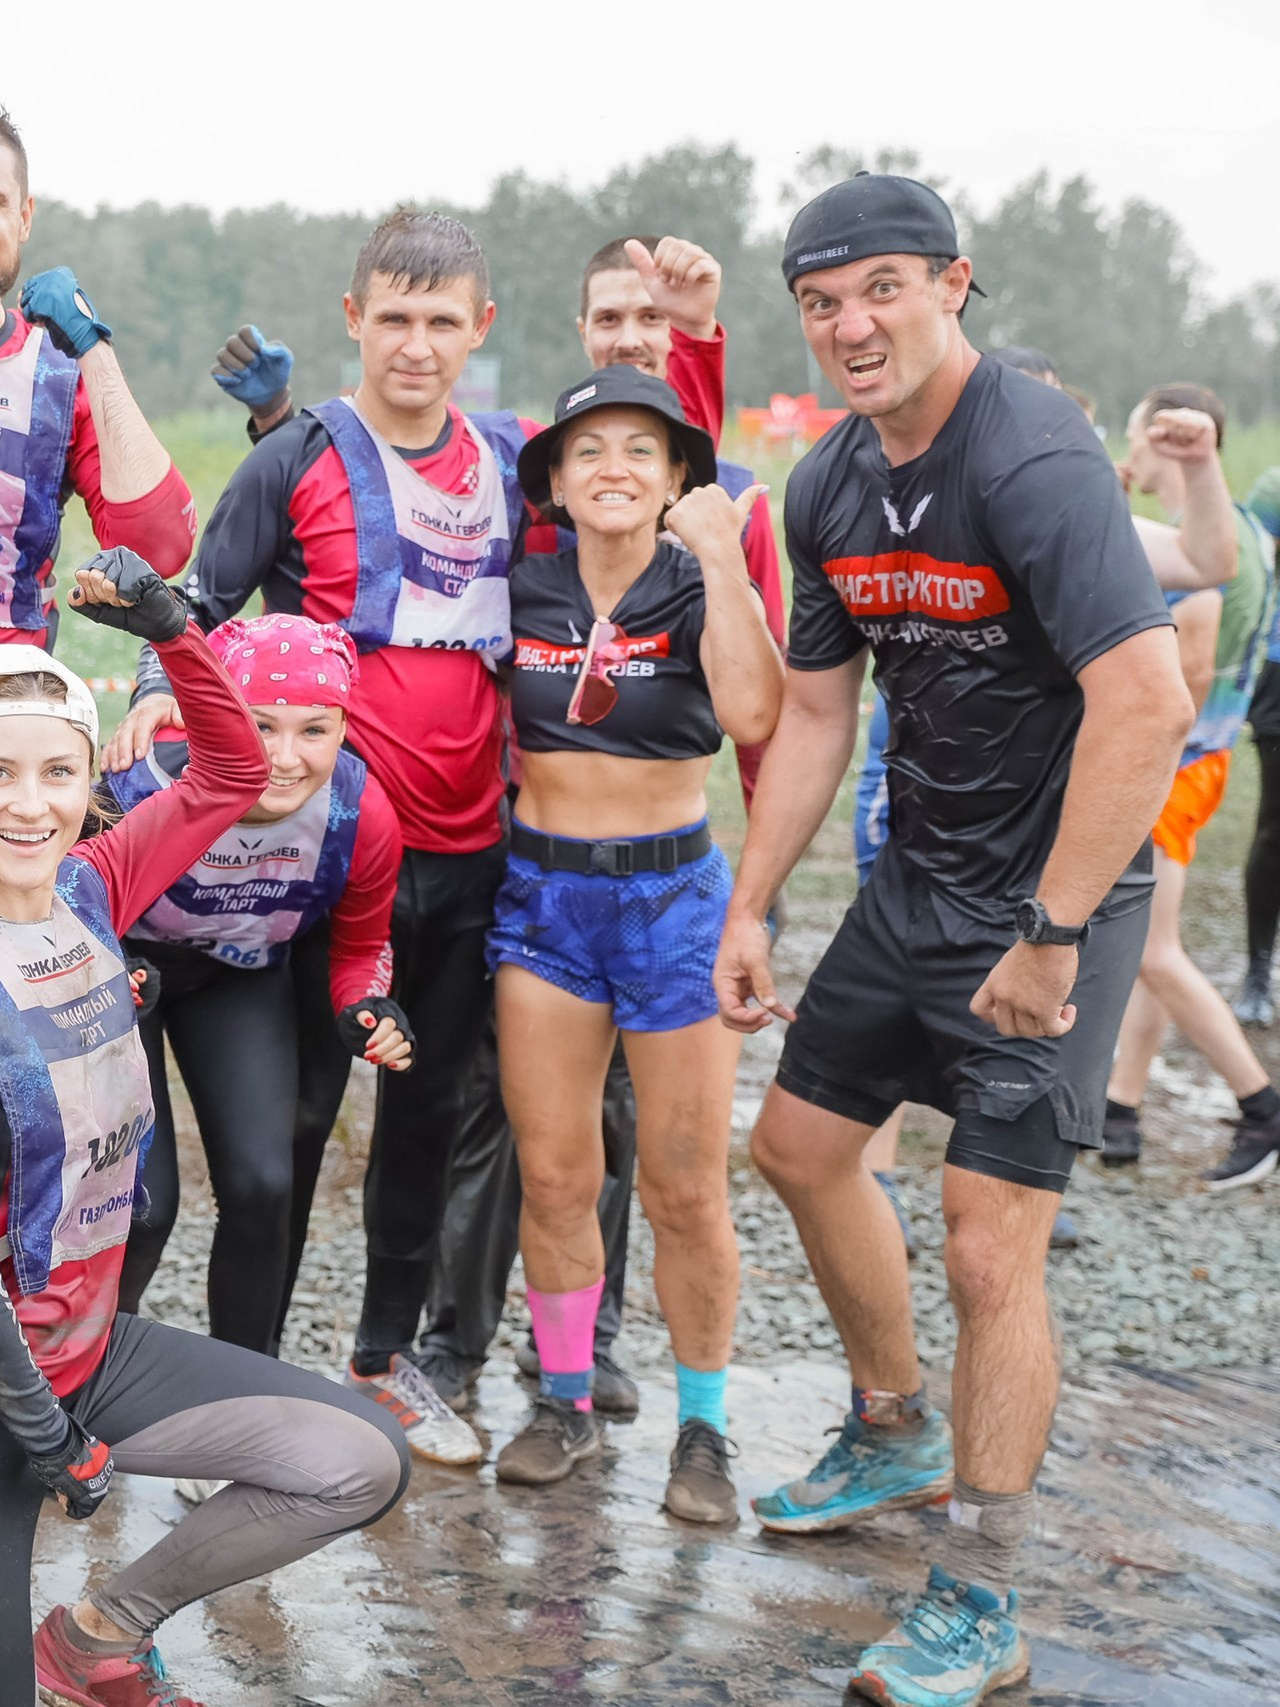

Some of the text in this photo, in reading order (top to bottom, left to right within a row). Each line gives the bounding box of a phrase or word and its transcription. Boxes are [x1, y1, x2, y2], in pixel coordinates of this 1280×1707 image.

[412, 508, 452, 534] ГОНКА
[202, 851, 242, 866] ОНКА
[81, 1107, 152, 1180] 1020
[88, 1472, 107, 1489] BIKE
